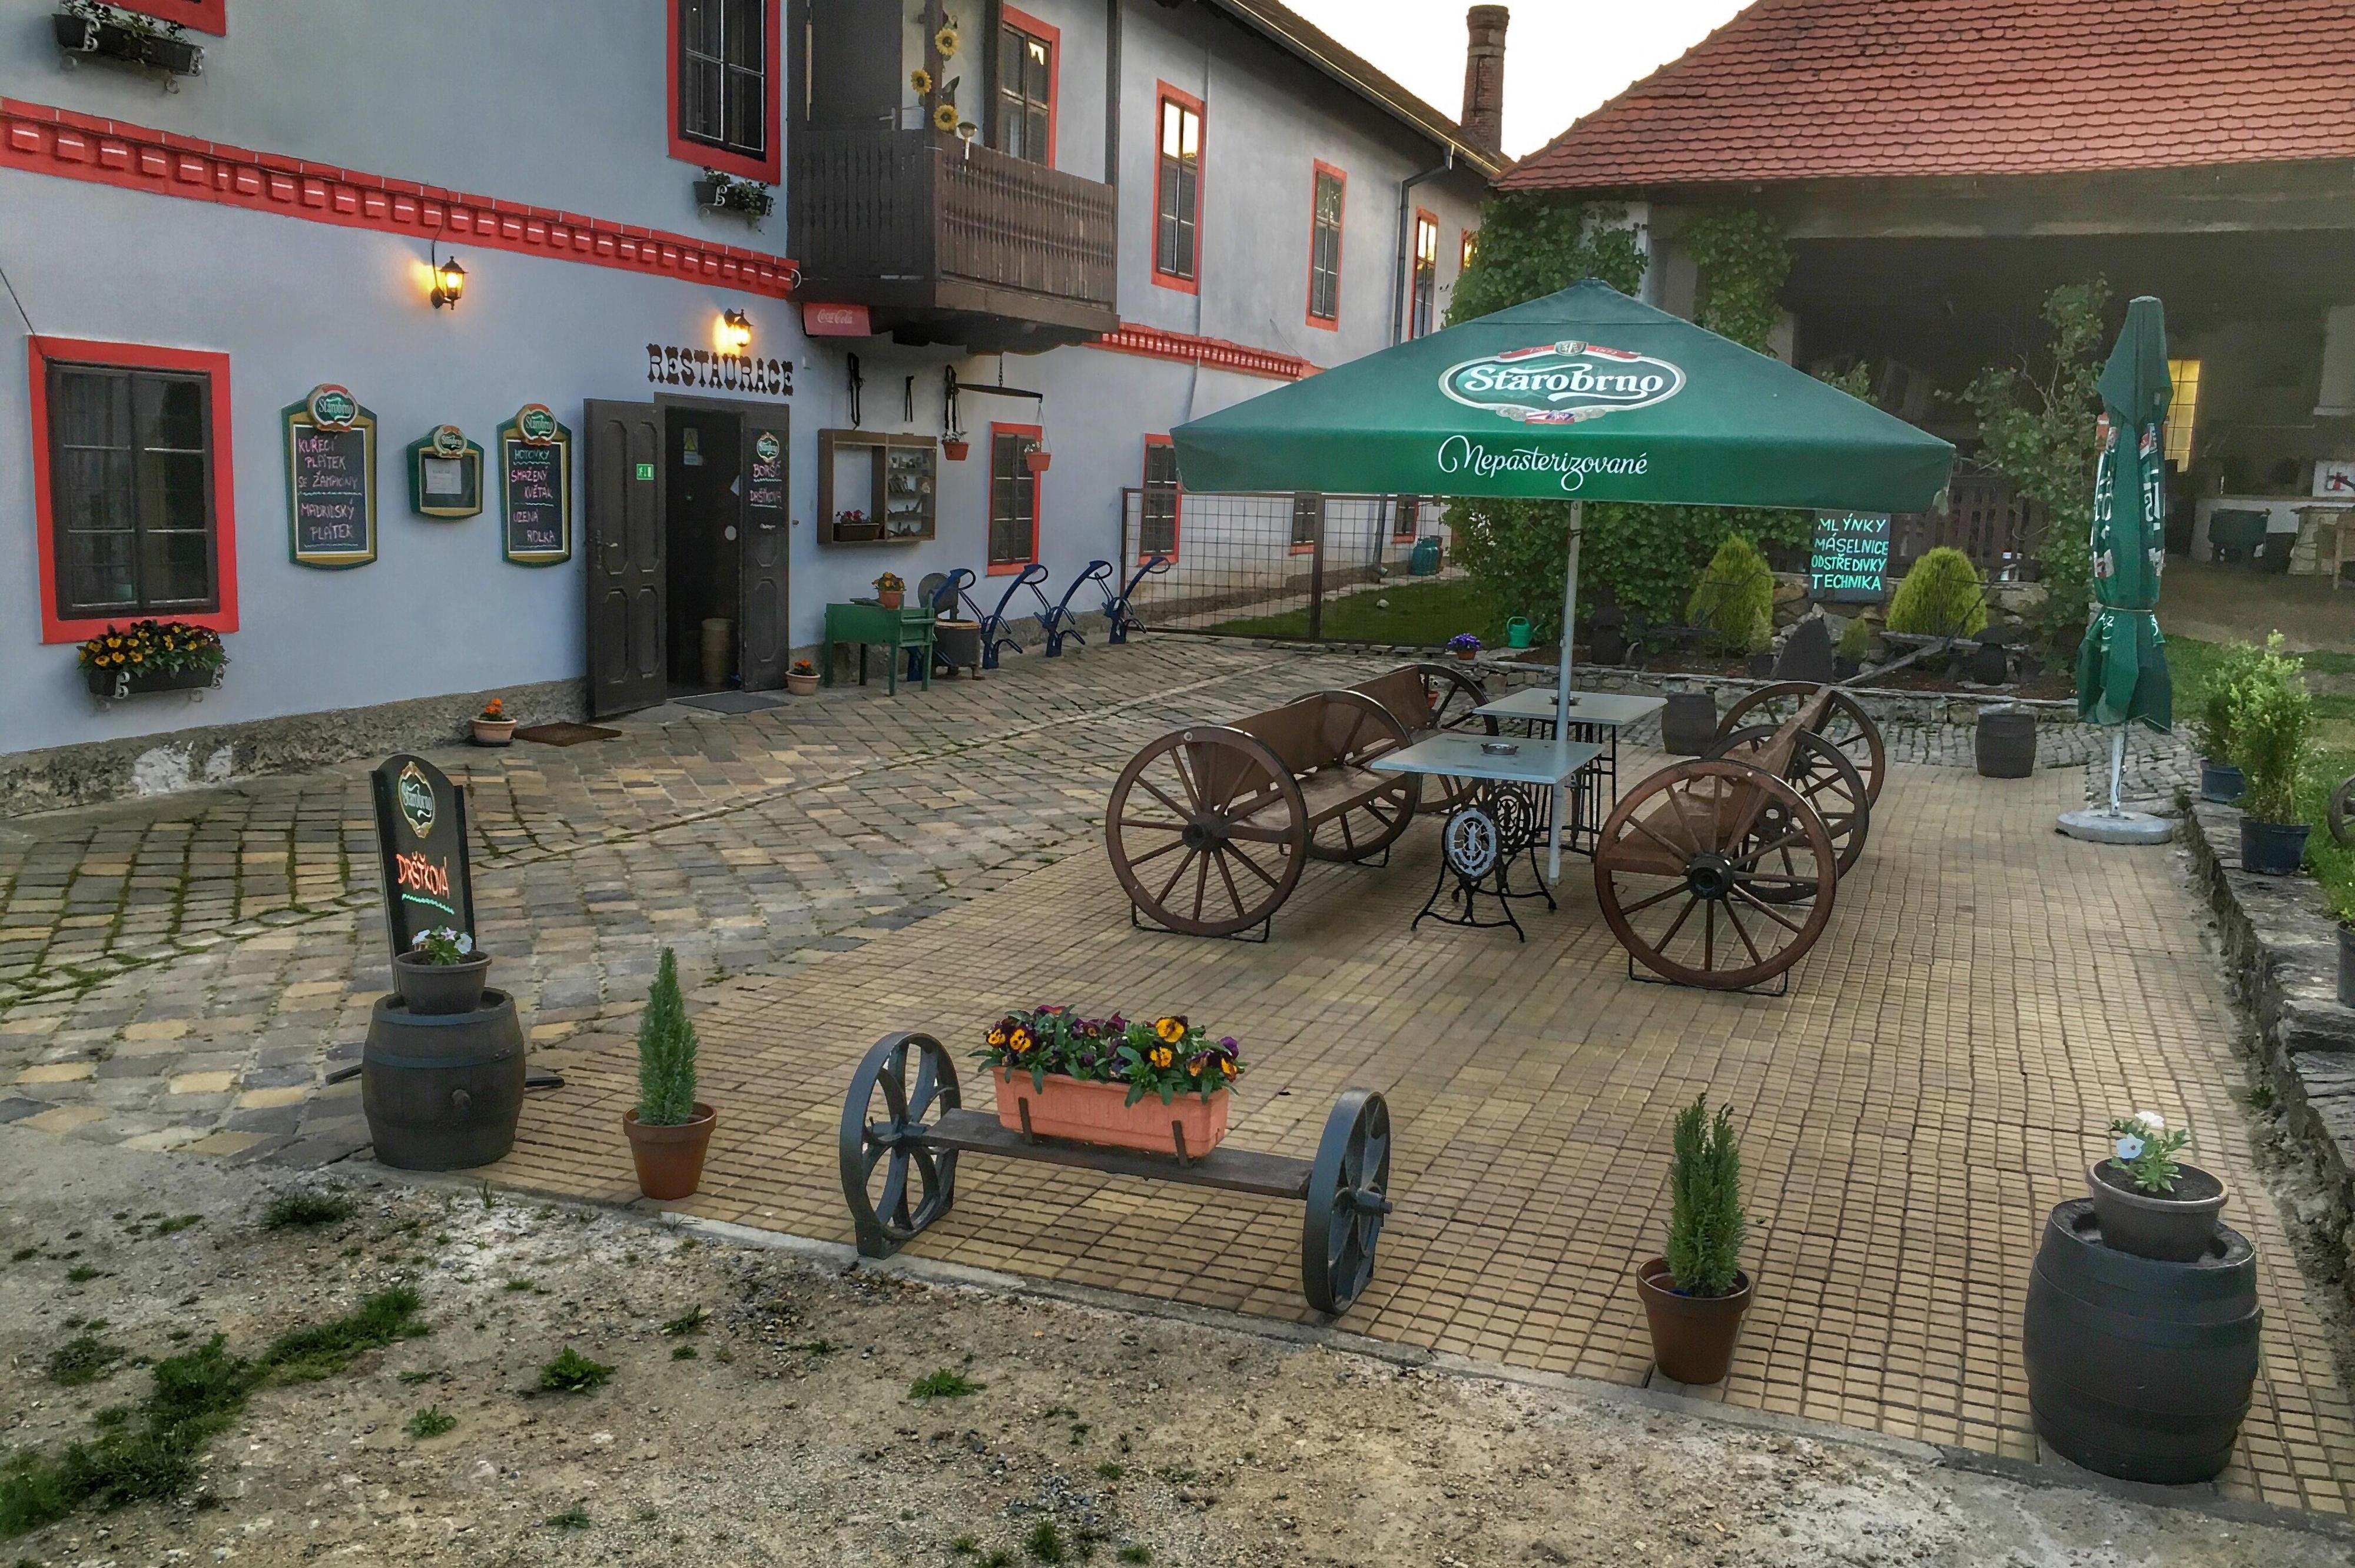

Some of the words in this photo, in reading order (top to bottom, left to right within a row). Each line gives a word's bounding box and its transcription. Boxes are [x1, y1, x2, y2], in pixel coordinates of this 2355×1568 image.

[646, 343, 794, 397] RESTAURACE
[1464, 363, 1664, 402] Starobrno
[298, 435, 338, 453] KUŘECÍ
[305, 454, 346, 470] PLÁTEK
[1438, 434, 1648, 491] Nepasterizované
[511, 466, 548, 482] SMAŽENÝ
[310, 523, 353, 541] PLÁTEK
[527, 530, 555, 543] ROLKA
[1815, 533, 1889, 555] MÁSELNICE
[1811, 553, 1887, 572] ODSTŘEDIVKY
[1812, 574, 1882, 591] TECHNIKA
